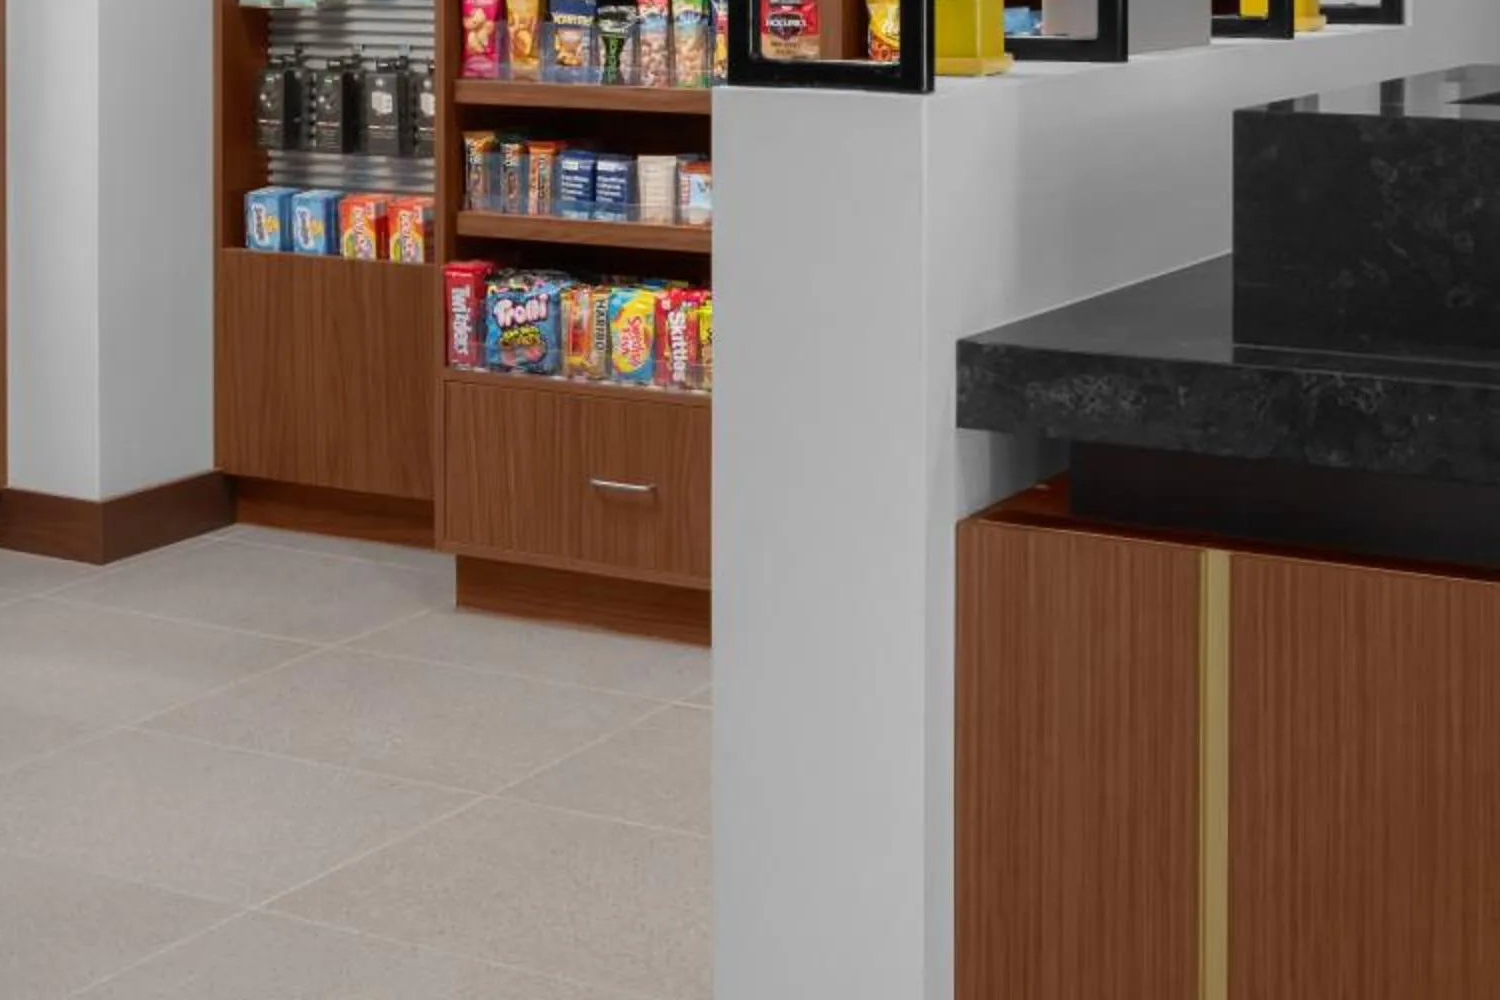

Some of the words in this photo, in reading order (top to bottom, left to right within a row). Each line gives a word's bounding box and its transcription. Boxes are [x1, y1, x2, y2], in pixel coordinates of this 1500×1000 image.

[493, 293, 549, 328] Trolli
[594, 299, 608, 352] HARIBO
[668, 309, 688, 382] Skittles
